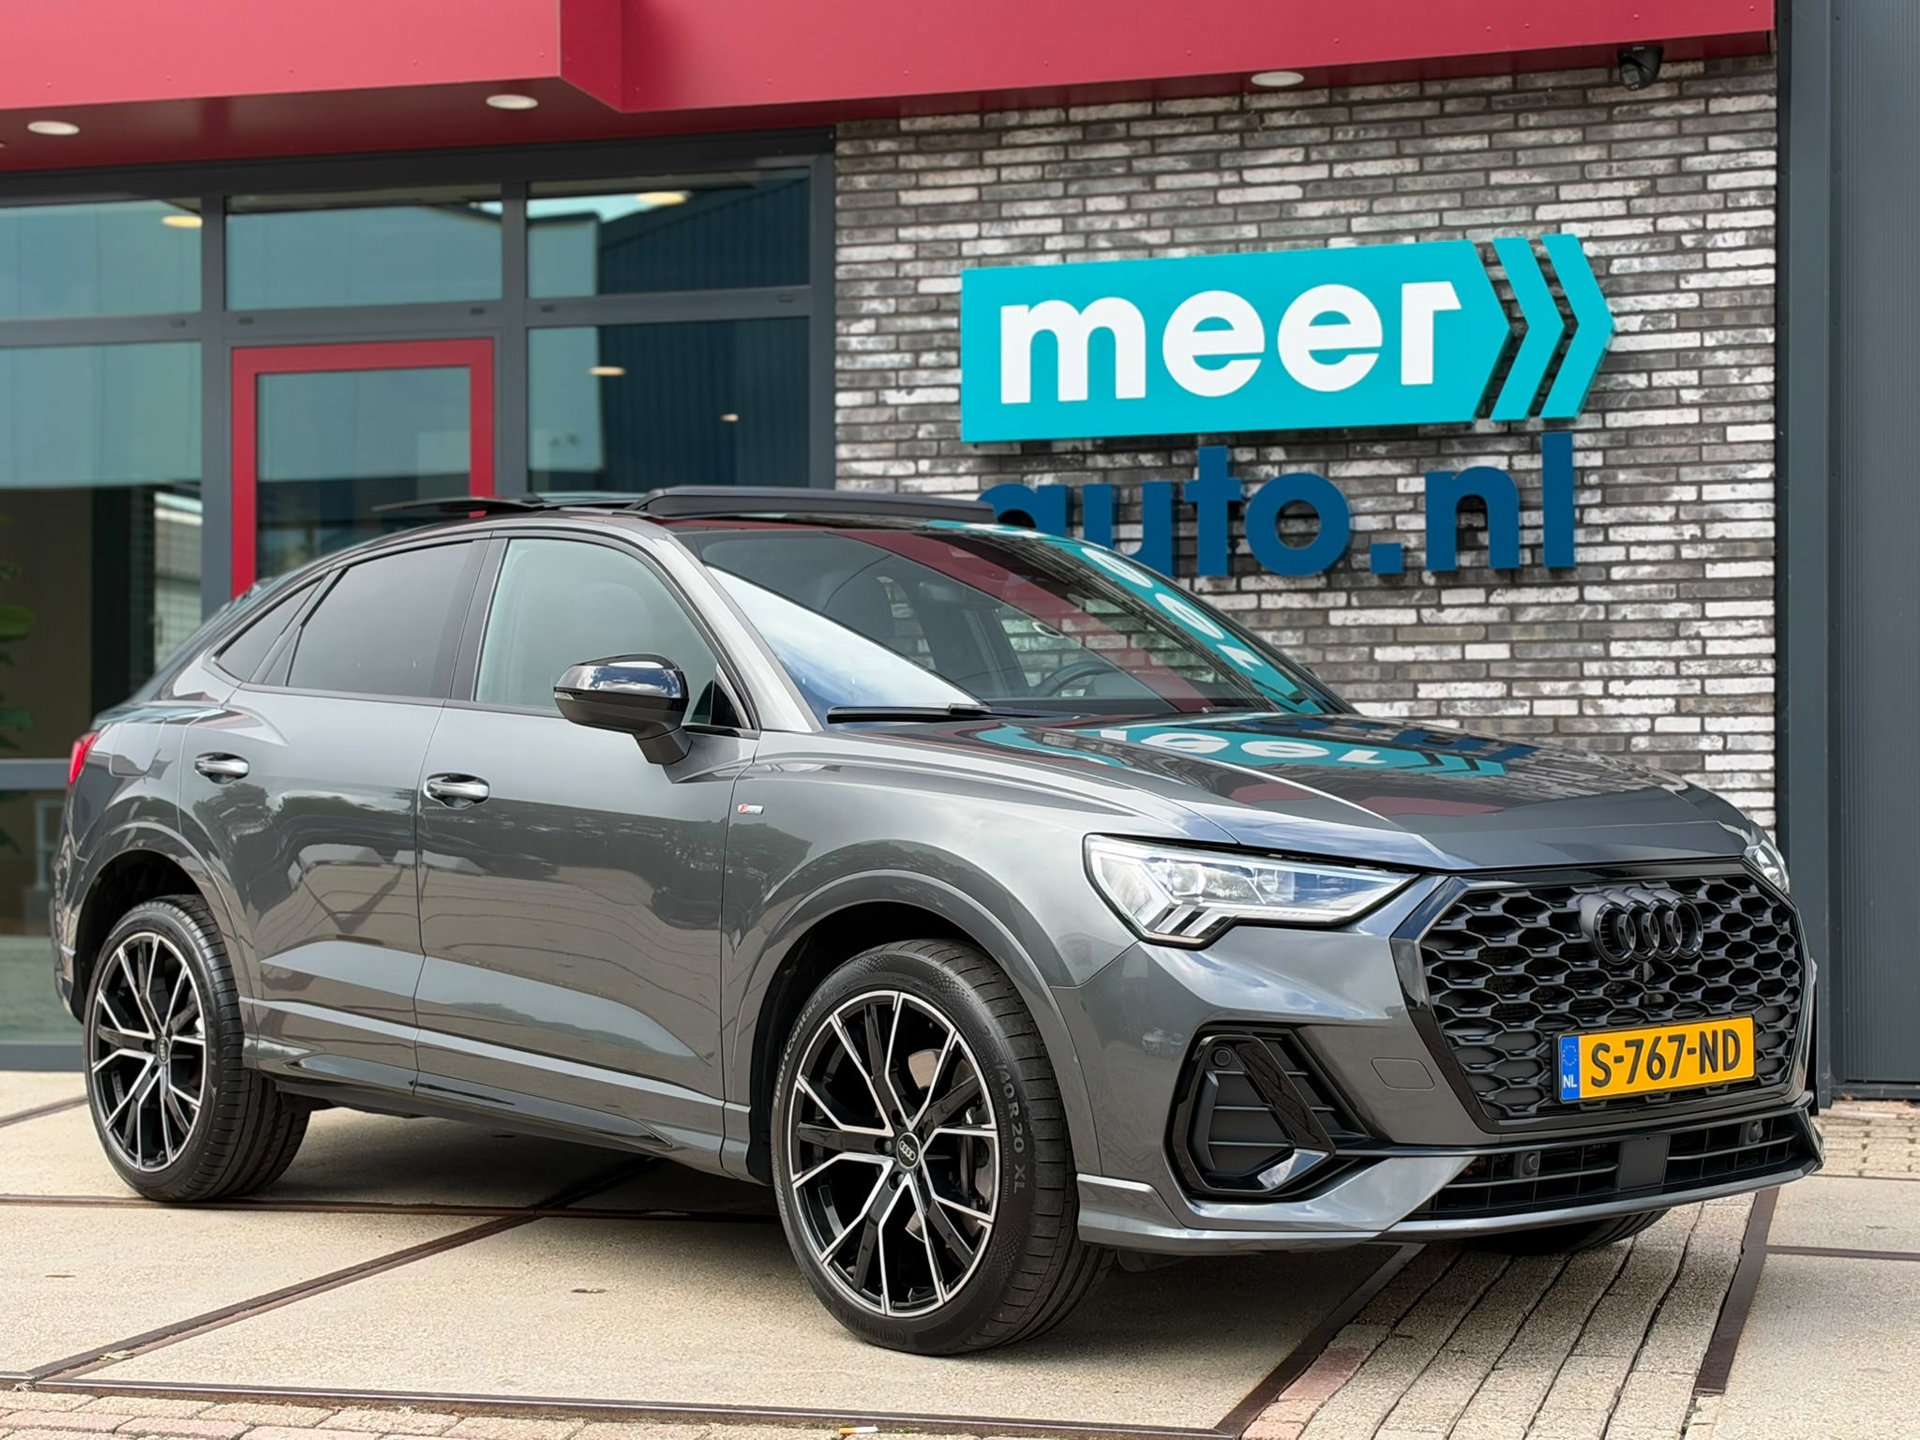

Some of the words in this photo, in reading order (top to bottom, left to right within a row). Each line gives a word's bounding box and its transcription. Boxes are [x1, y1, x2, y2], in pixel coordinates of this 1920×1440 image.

[1001, 281, 1462, 404] meer
[1562, 1074, 1577, 1088] NL
[1591, 1029, 1741, 1088] S-767-ND
[1014, 1163, 1026, 1194] XL
